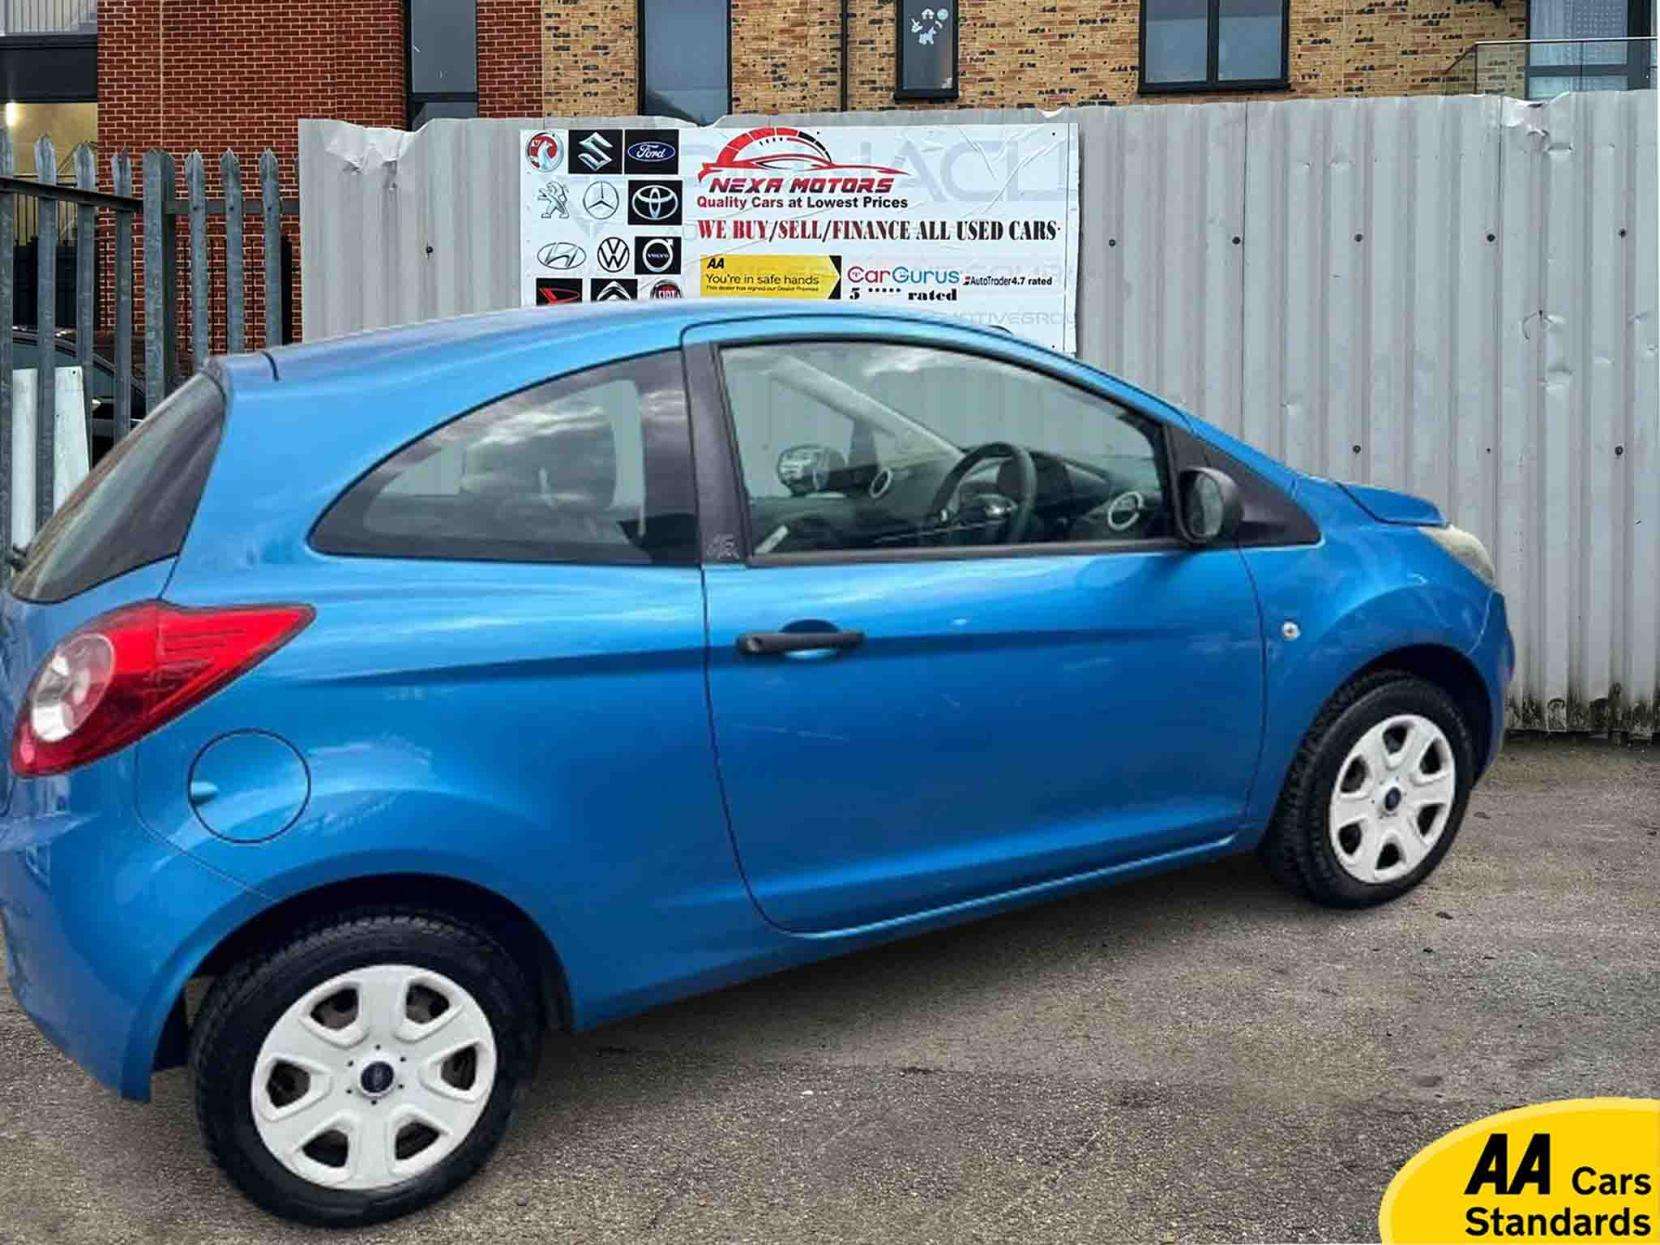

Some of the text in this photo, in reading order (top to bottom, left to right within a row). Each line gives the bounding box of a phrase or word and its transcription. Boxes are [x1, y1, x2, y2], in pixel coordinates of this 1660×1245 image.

[636, 144, 666, 158] Ford
[709, 178, 894, 193] NEXA MOTORS
[697, 196, 908, 209] Quality Cars at Lowest Prices
[698, 220, 727, 239] WE
[917, 221, 950, 240] ALL
[957, 221, 1003, 240] USED
[1009, 221, 1057, 240] CARS
[707, 258, 725, 269] AA
[706, 274, 819, 285] You're in safe hands
[847, 266, 960, 284] CarGurus
[1028, 276, 1053, 286] rated
[849, 287, 957, 300] 5 rated
